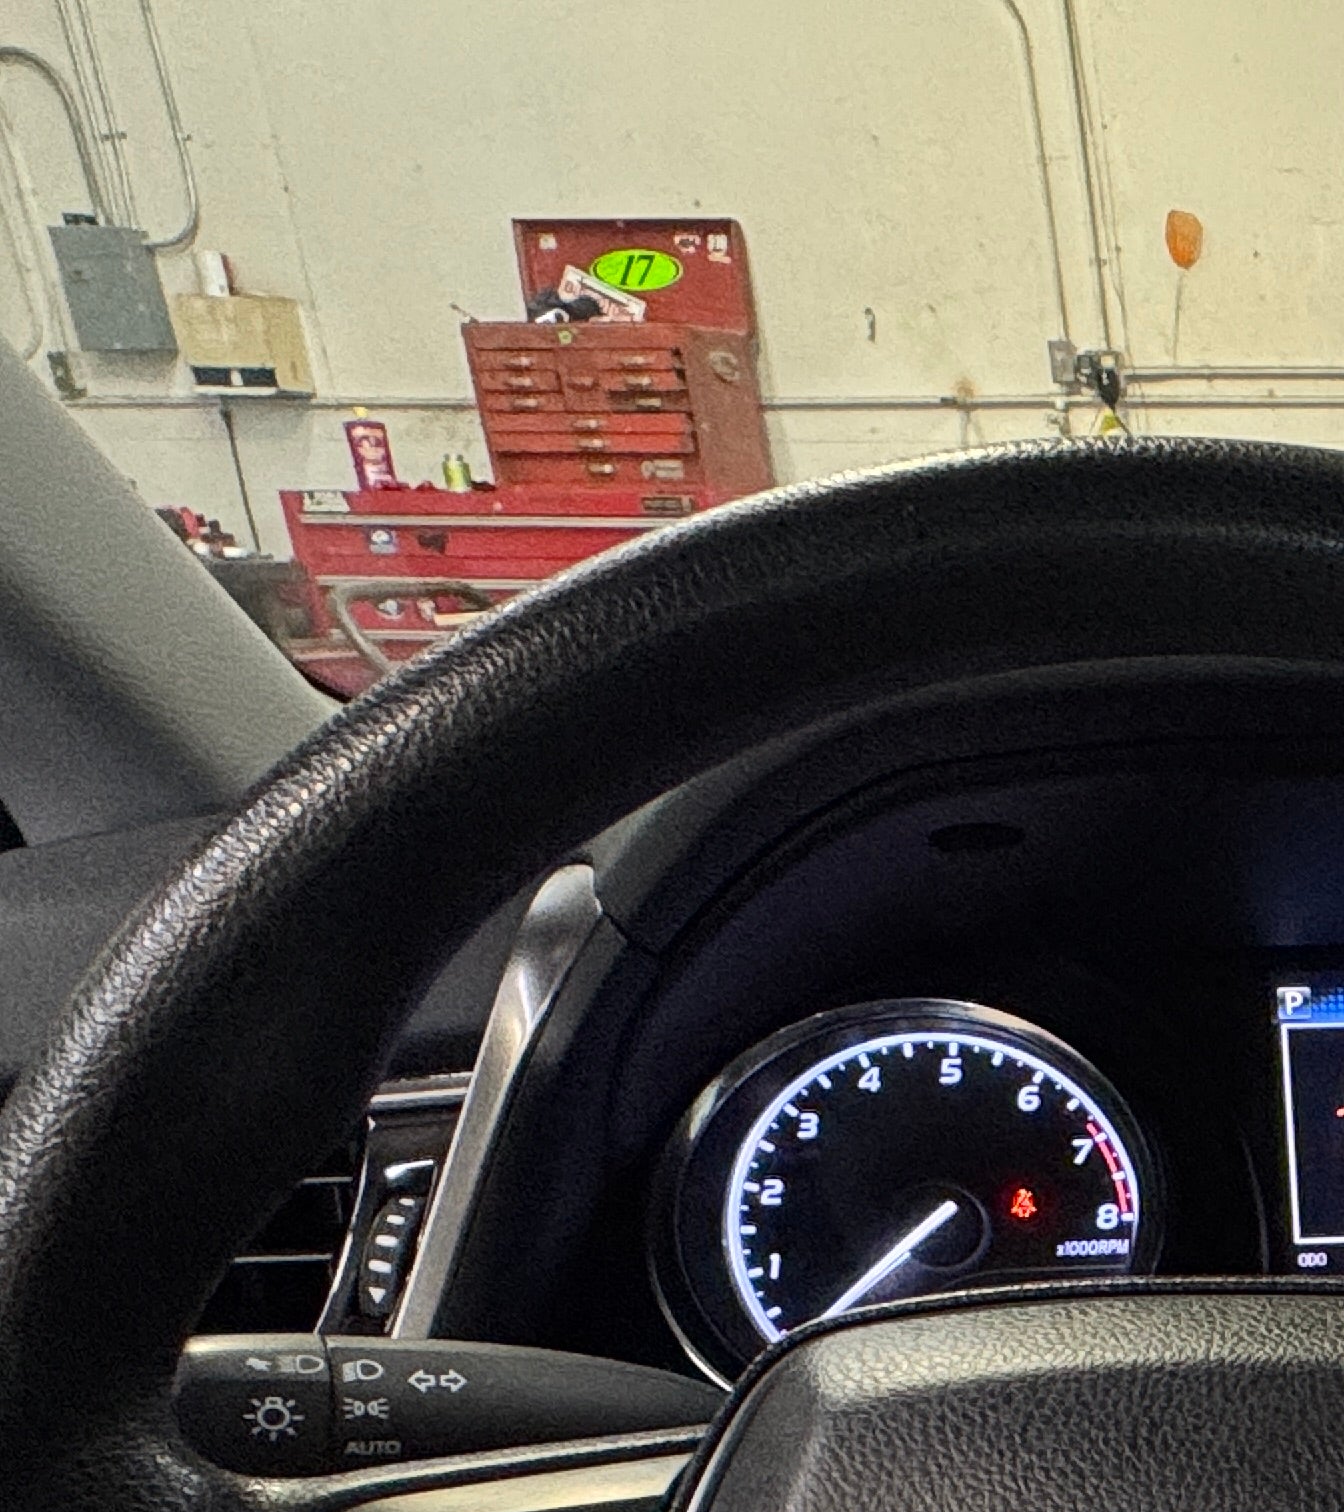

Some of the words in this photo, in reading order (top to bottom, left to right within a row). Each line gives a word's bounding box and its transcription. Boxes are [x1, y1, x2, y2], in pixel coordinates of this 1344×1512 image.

[619, 254, 655, 286] 17
[1284, 990, 1304, 1016] P
[858, 1066, 882, 1093] 4
[939, 1058, 962, 1085] 5
[1017, 1086, 1041, 1112] 6
[796, 1112, 820, 1140] 3
[1071, 1139, 1094, 1166] 7
[760, 1178, 785, 1206] 2
[1095, 1203, 1119, 1230] 8
[768, 1253, 782, 1279] 1
[344, 1440, 401, 1456] AUTO
